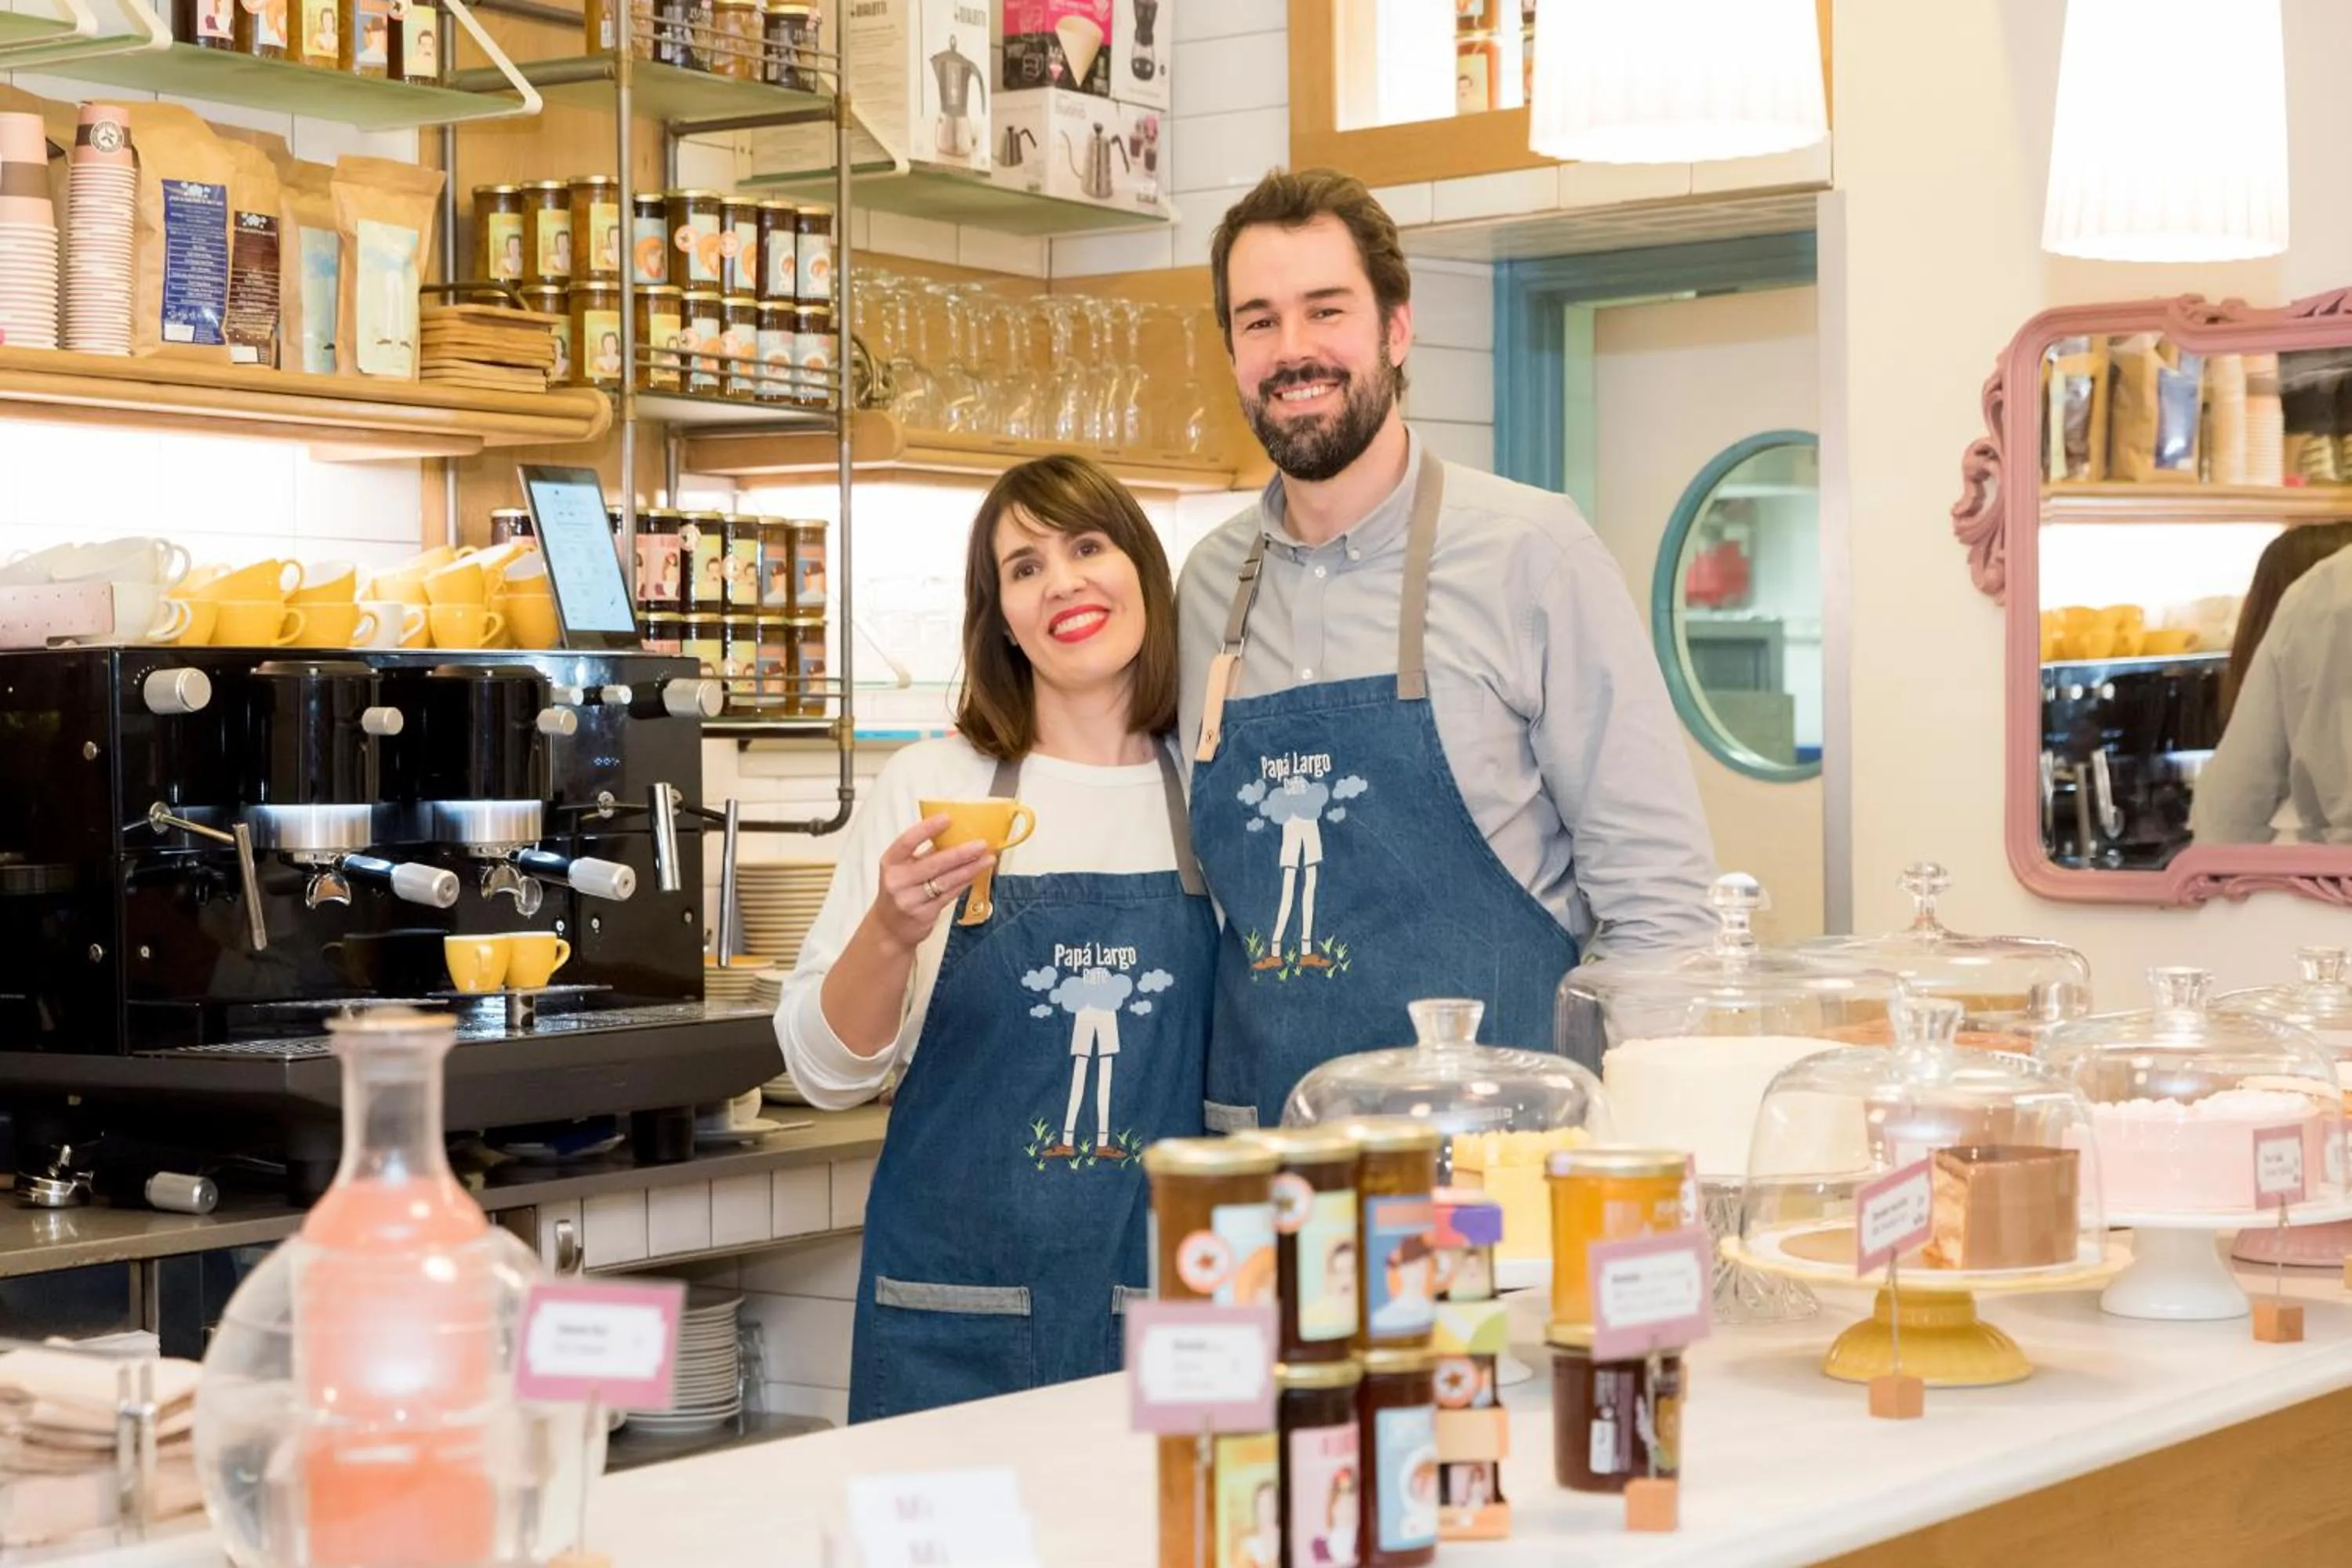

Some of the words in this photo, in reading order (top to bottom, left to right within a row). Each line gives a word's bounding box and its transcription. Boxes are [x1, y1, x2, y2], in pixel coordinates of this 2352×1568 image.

[1261, 752, 1290, 782] Papá
[1293, 750, 1332, 779] Largo
[1054, 942, 1091, 973] Papá
[1096, 941, 1137, 971] Largo
